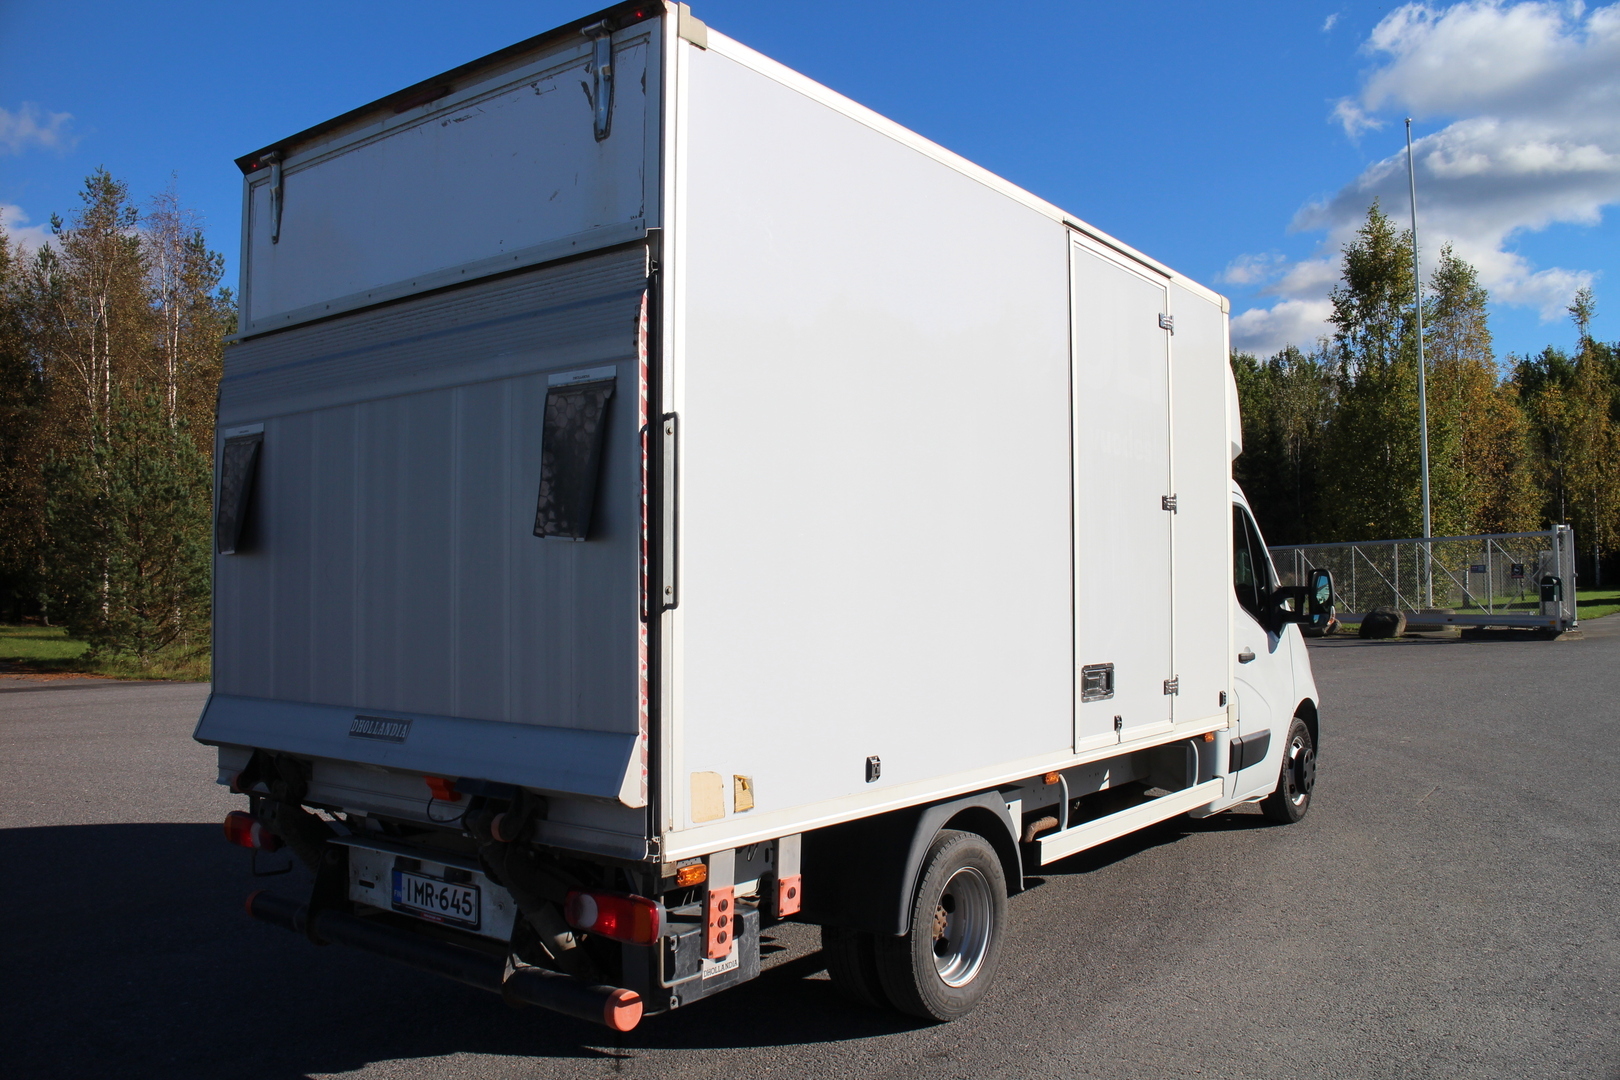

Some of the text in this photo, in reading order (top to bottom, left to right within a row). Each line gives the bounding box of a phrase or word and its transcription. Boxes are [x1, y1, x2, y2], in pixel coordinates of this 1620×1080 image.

[350, 719, 408, 738] DHOLLANDIA
[407, 878, 472, 916] IMR-645
[703, 960, 738, 977] DHOLLANDIA
